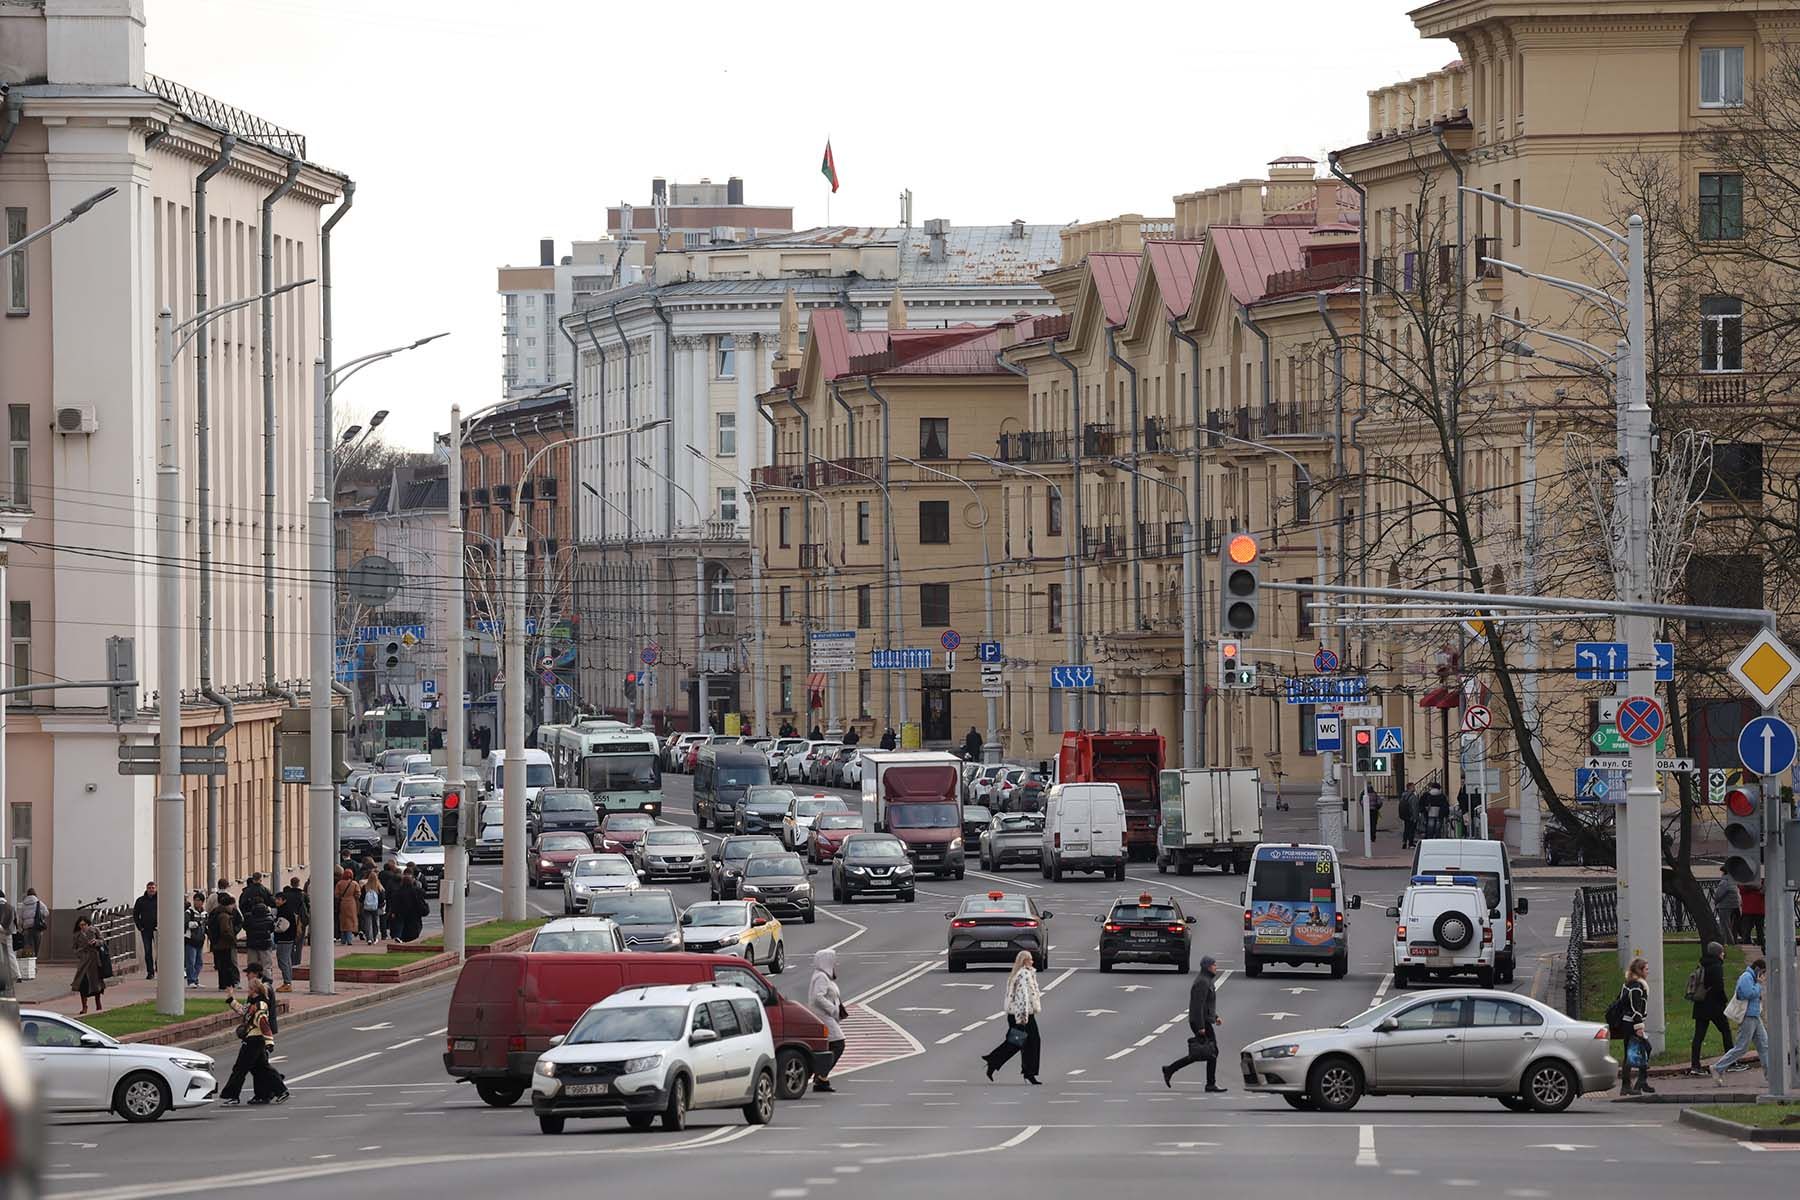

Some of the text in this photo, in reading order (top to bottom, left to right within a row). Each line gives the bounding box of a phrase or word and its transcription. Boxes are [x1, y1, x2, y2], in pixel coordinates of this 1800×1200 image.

[985, 644, 997, 660] P
[425, 681, 433, 691] P
[1349, 708, 1377, 717] STOP
[1320, 724, 1336, 733] WC
[1317, 863, 1330, 873] 56
